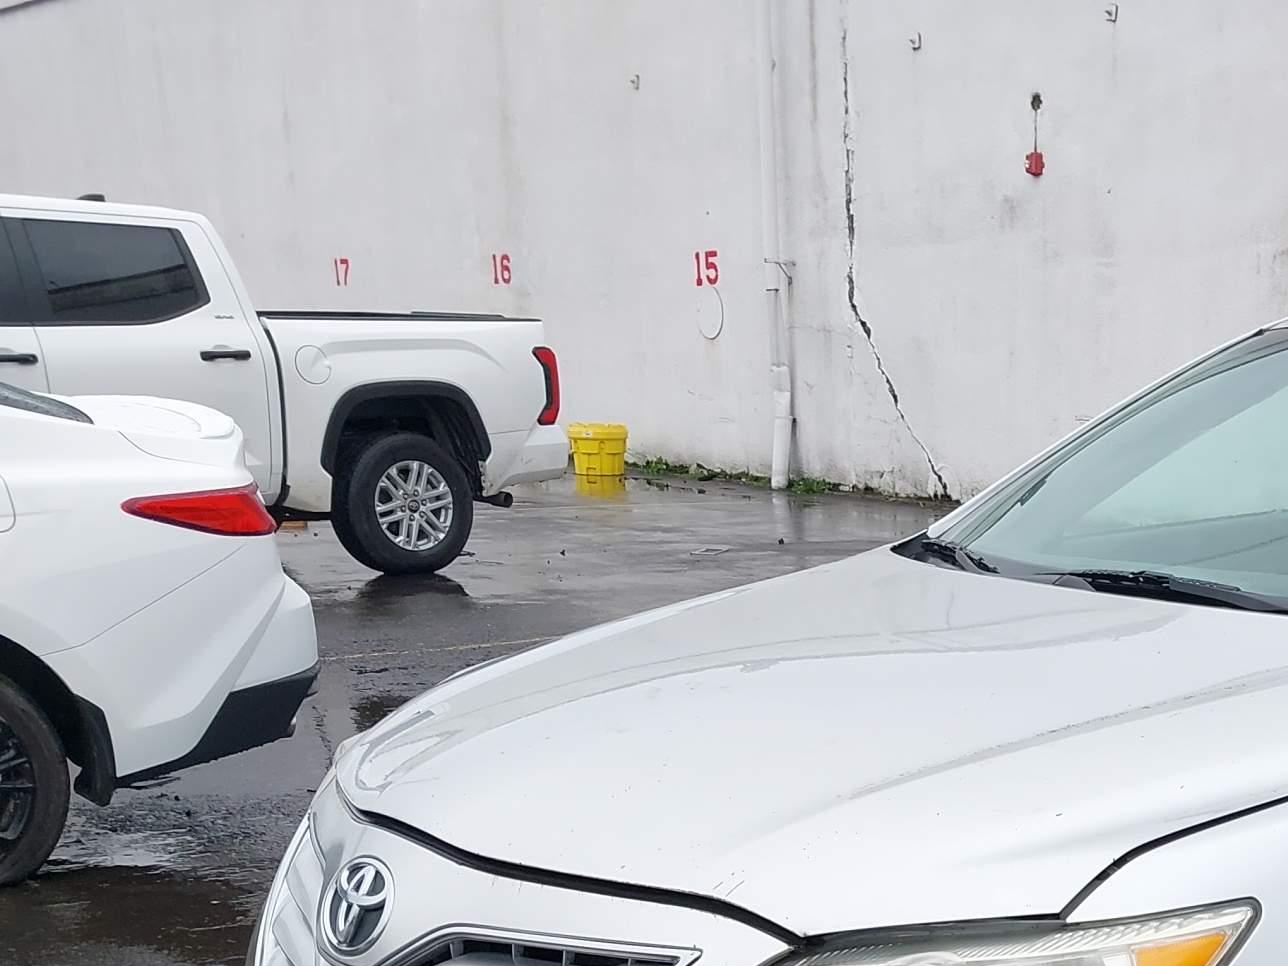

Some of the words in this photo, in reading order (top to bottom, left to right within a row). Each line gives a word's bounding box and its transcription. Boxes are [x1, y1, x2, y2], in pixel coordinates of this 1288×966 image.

[334, 257, 350, 286] 17
[492, 253, 512, 285] 16
[694, 250, 720, 286] 15
